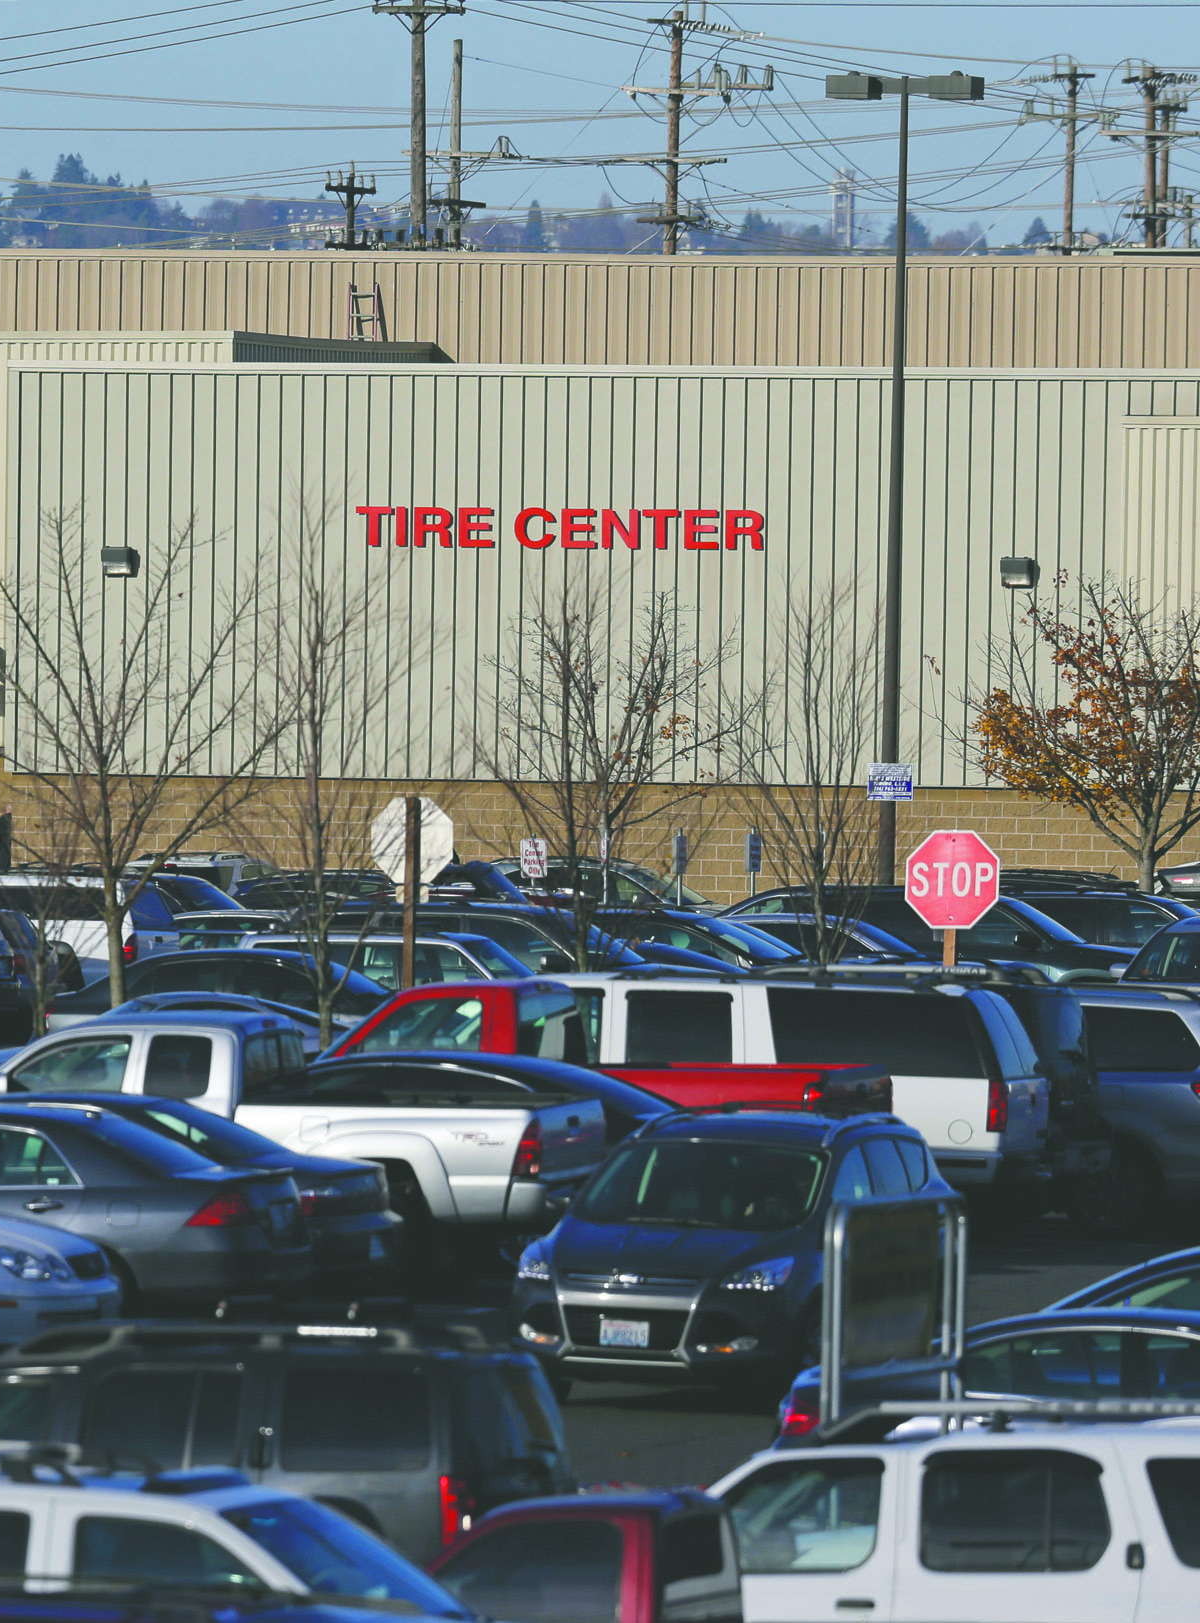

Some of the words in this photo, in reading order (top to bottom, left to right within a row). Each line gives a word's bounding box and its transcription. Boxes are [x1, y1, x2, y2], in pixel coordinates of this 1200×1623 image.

[355, 506, 495, 548] TIRE
[514, 507, 765, 550] CENTER
[524, 858, 545, 867] Parkng
[528, 866, 540, 876] Only
[910, 862, 994, 897] STOP
